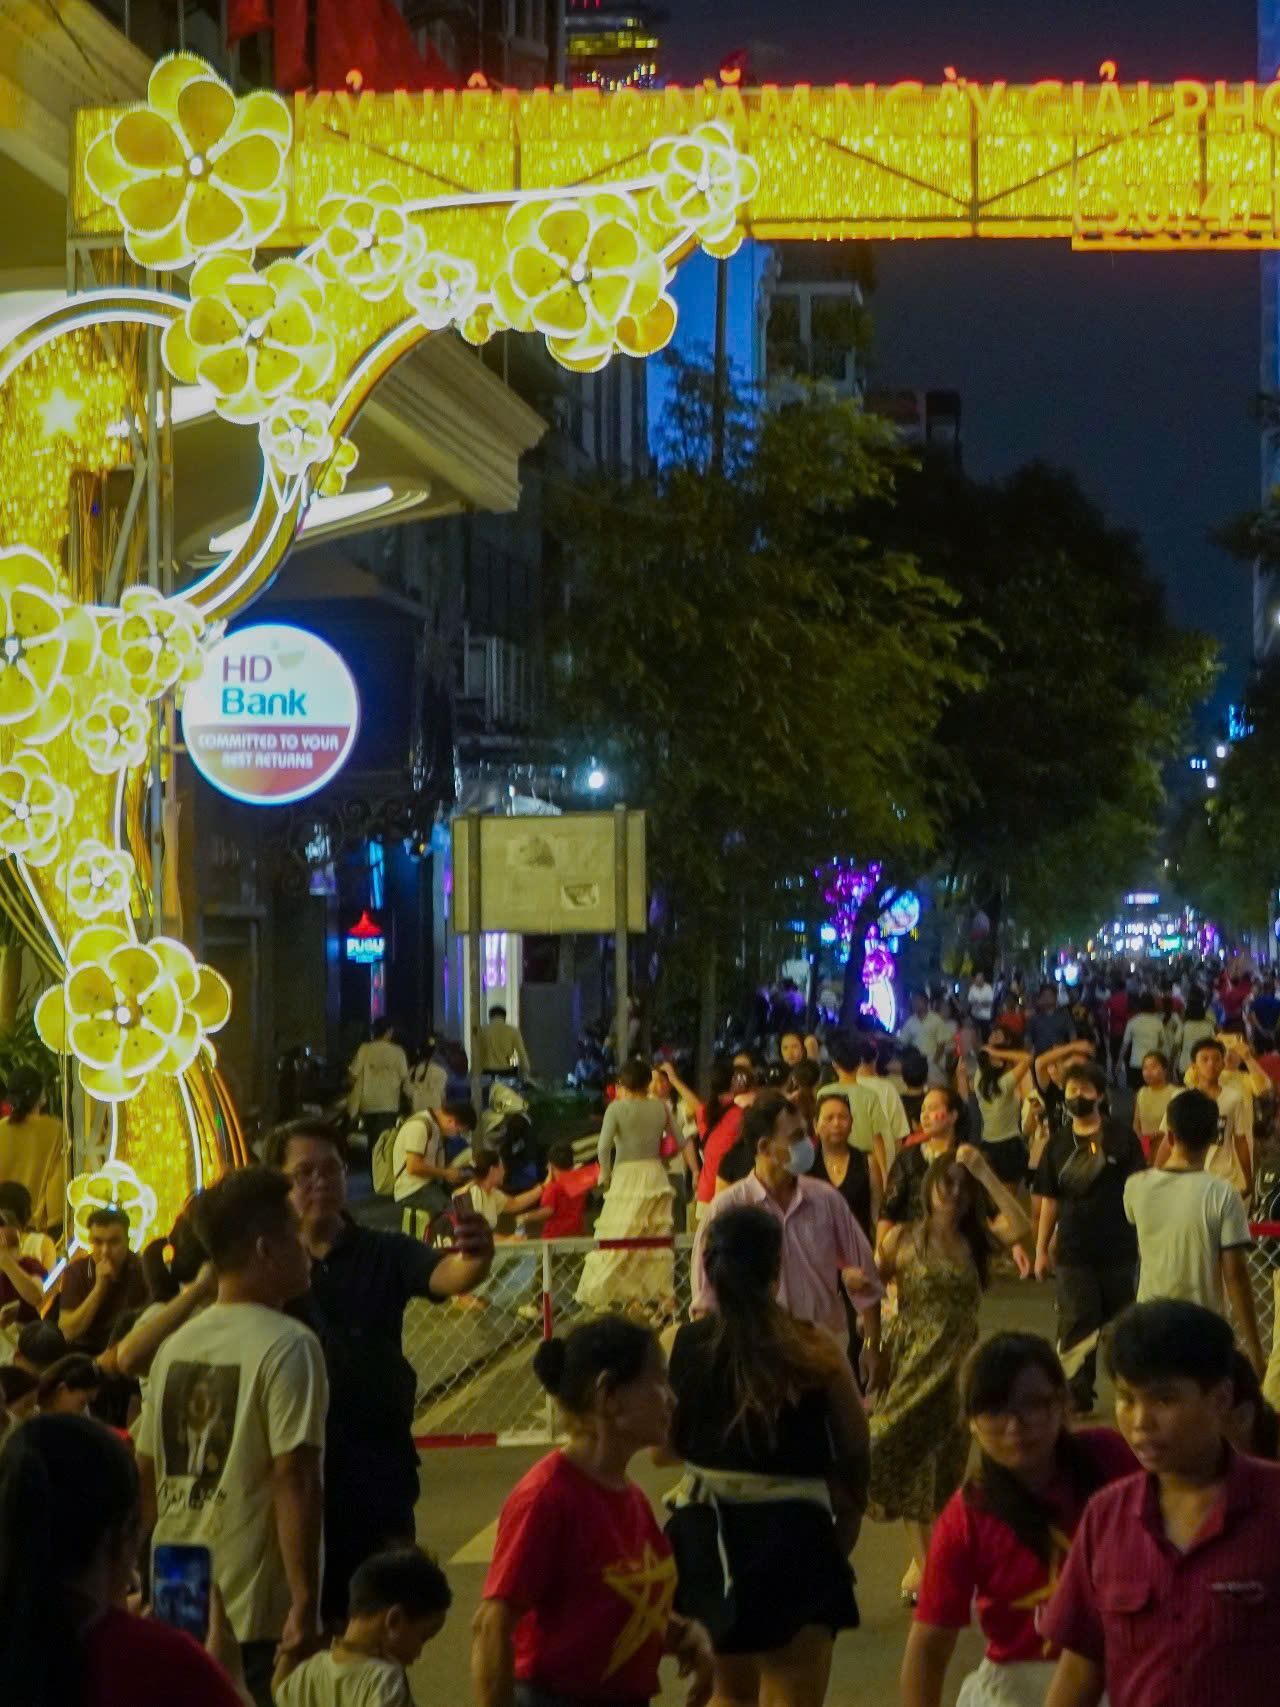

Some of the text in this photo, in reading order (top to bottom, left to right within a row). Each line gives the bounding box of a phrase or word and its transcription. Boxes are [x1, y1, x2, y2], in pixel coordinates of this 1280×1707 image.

[222, 654, 273, 683] HD
[221, 687, 307, 716] Bank
[199, 733, 339, 751] COMMITTED TO YOUR
